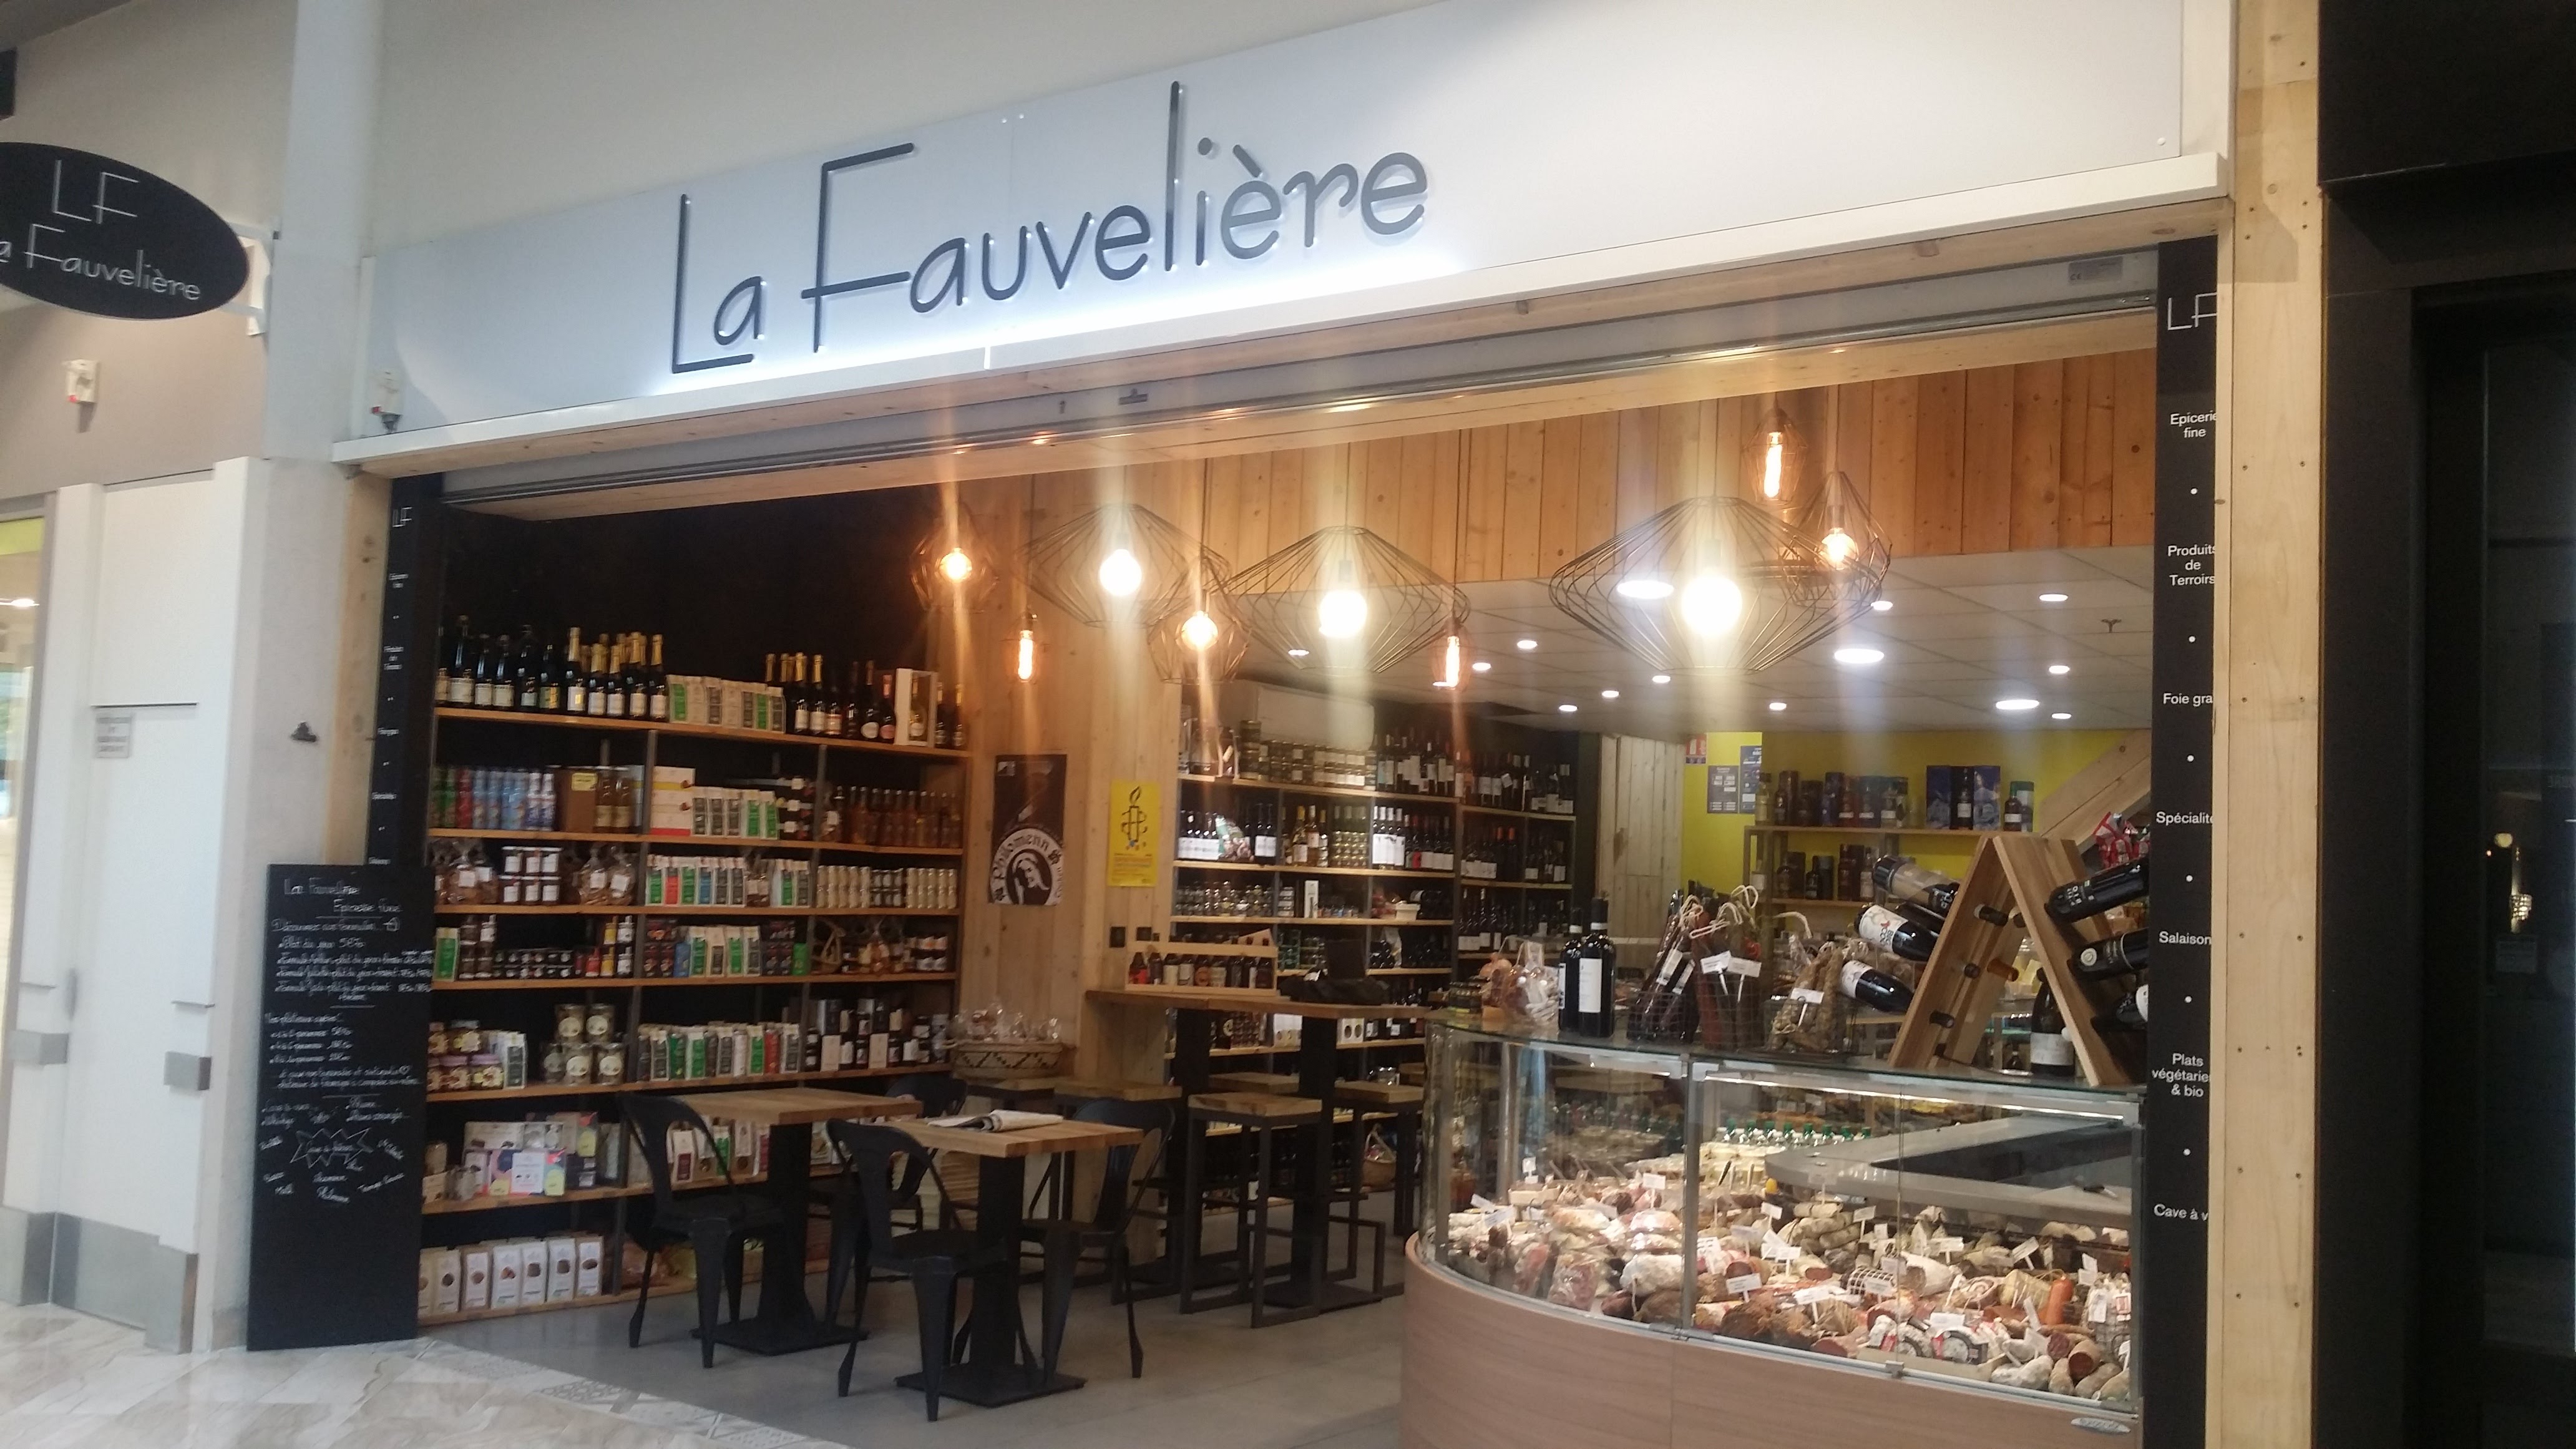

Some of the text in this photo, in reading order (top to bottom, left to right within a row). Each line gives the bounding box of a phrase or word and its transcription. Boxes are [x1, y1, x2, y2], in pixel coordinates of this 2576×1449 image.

[51, 159, 139, 224] LF
[671, 81, 1428, 374] La Fauvelière
[23, 223, 201, 300] Fauvelière
[2168, 292, 2217, 330] LF
[2170, 409, 2217, 426] Epicerie
[2183, 427, 2207, 438] fine
[2185, 559, 2201, 570] de
[2169, 573, 2215, 586] Terroirs
[2163, 693, 2189, 705] Foie
[2172, 1053, 2203, 1066] Plats
[2152, 1068, 2210, 1083] végétarie
[2171, 1083, 2203, 1097] & bio
[2154, 1204, 2187, 1218] Cave
[2190, 1208, 2198, 1220] à
